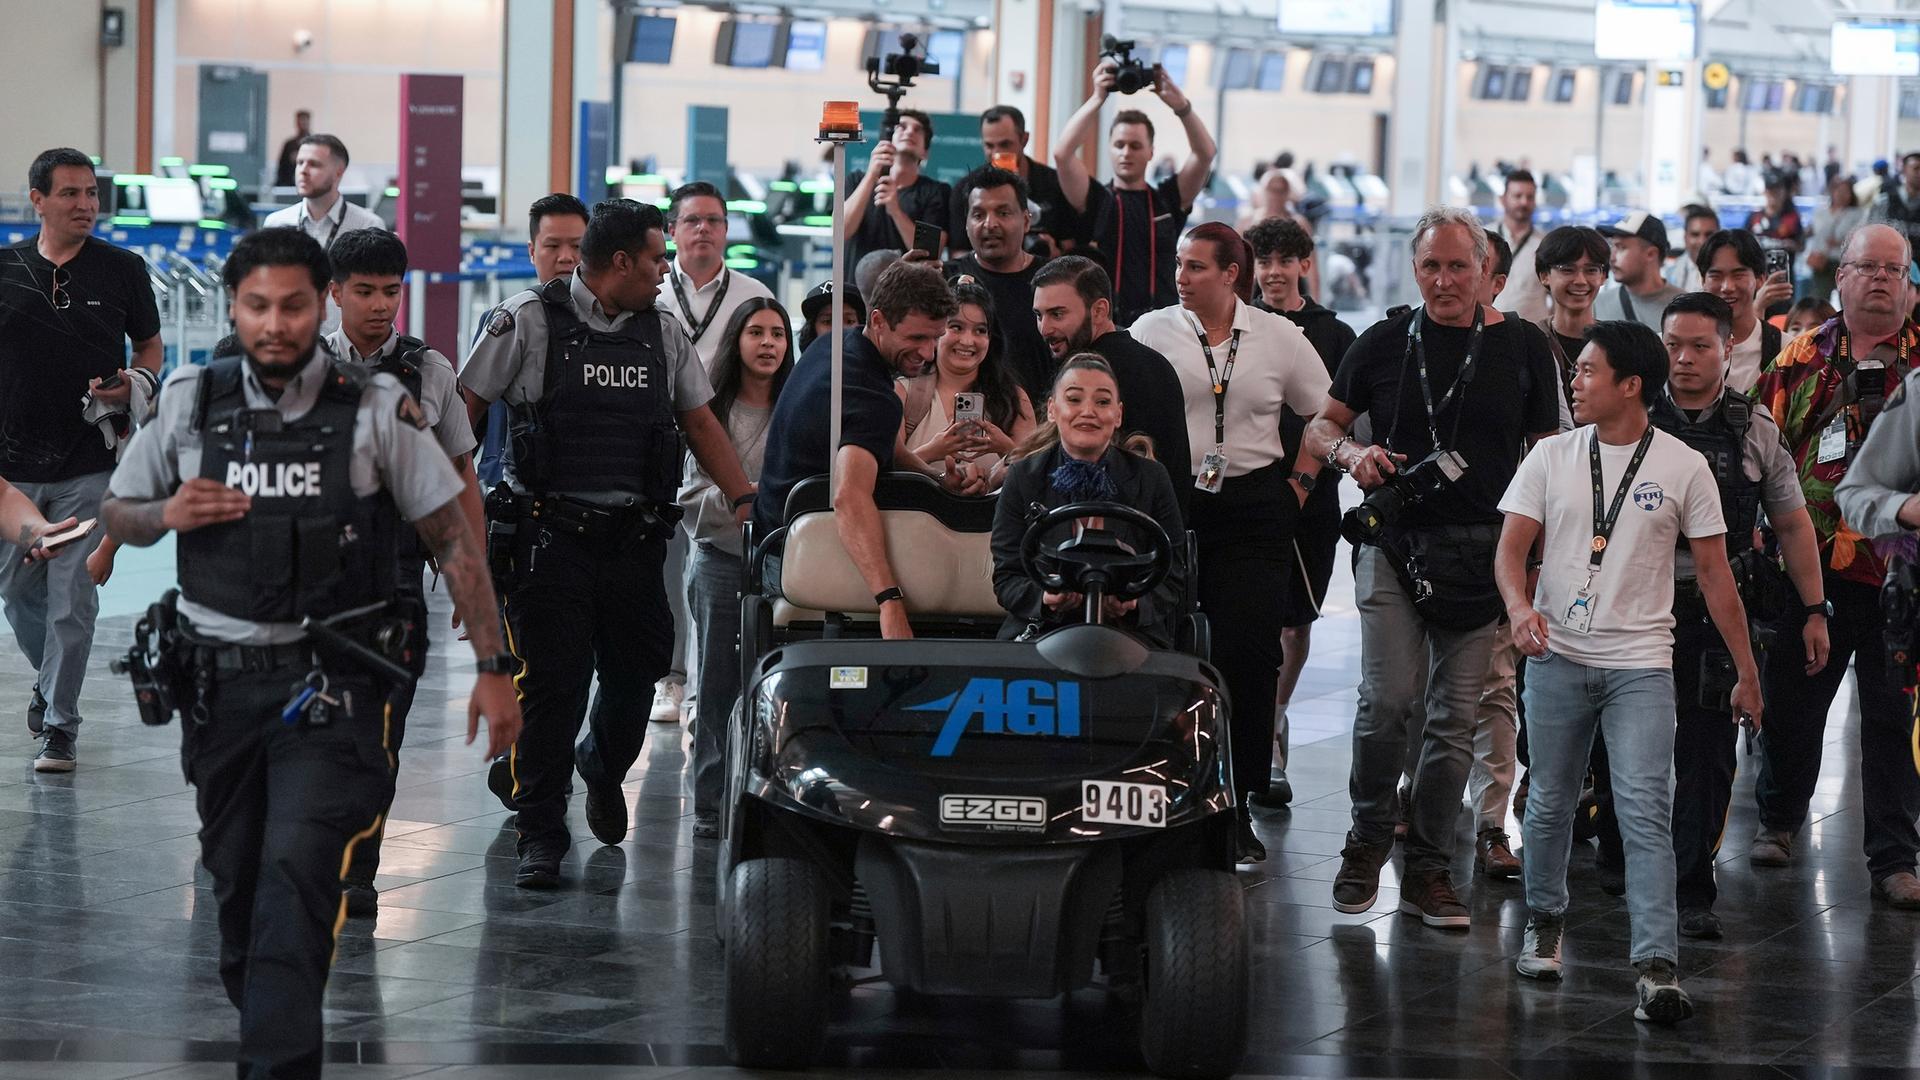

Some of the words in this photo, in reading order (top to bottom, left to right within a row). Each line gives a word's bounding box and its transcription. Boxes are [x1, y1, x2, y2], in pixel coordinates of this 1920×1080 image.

[1840, 335, 1848, 357] Nikon
[1900, 336, 1908, 360] Nikon
[583, 363, 649, 389] POLICE
[1818, 450, 1845, 463] 2025
[224, 461, 322, 498] POLICE
[901, 677, 1081, 757] AGI
[1085, 783, 1164, 824] 9403
